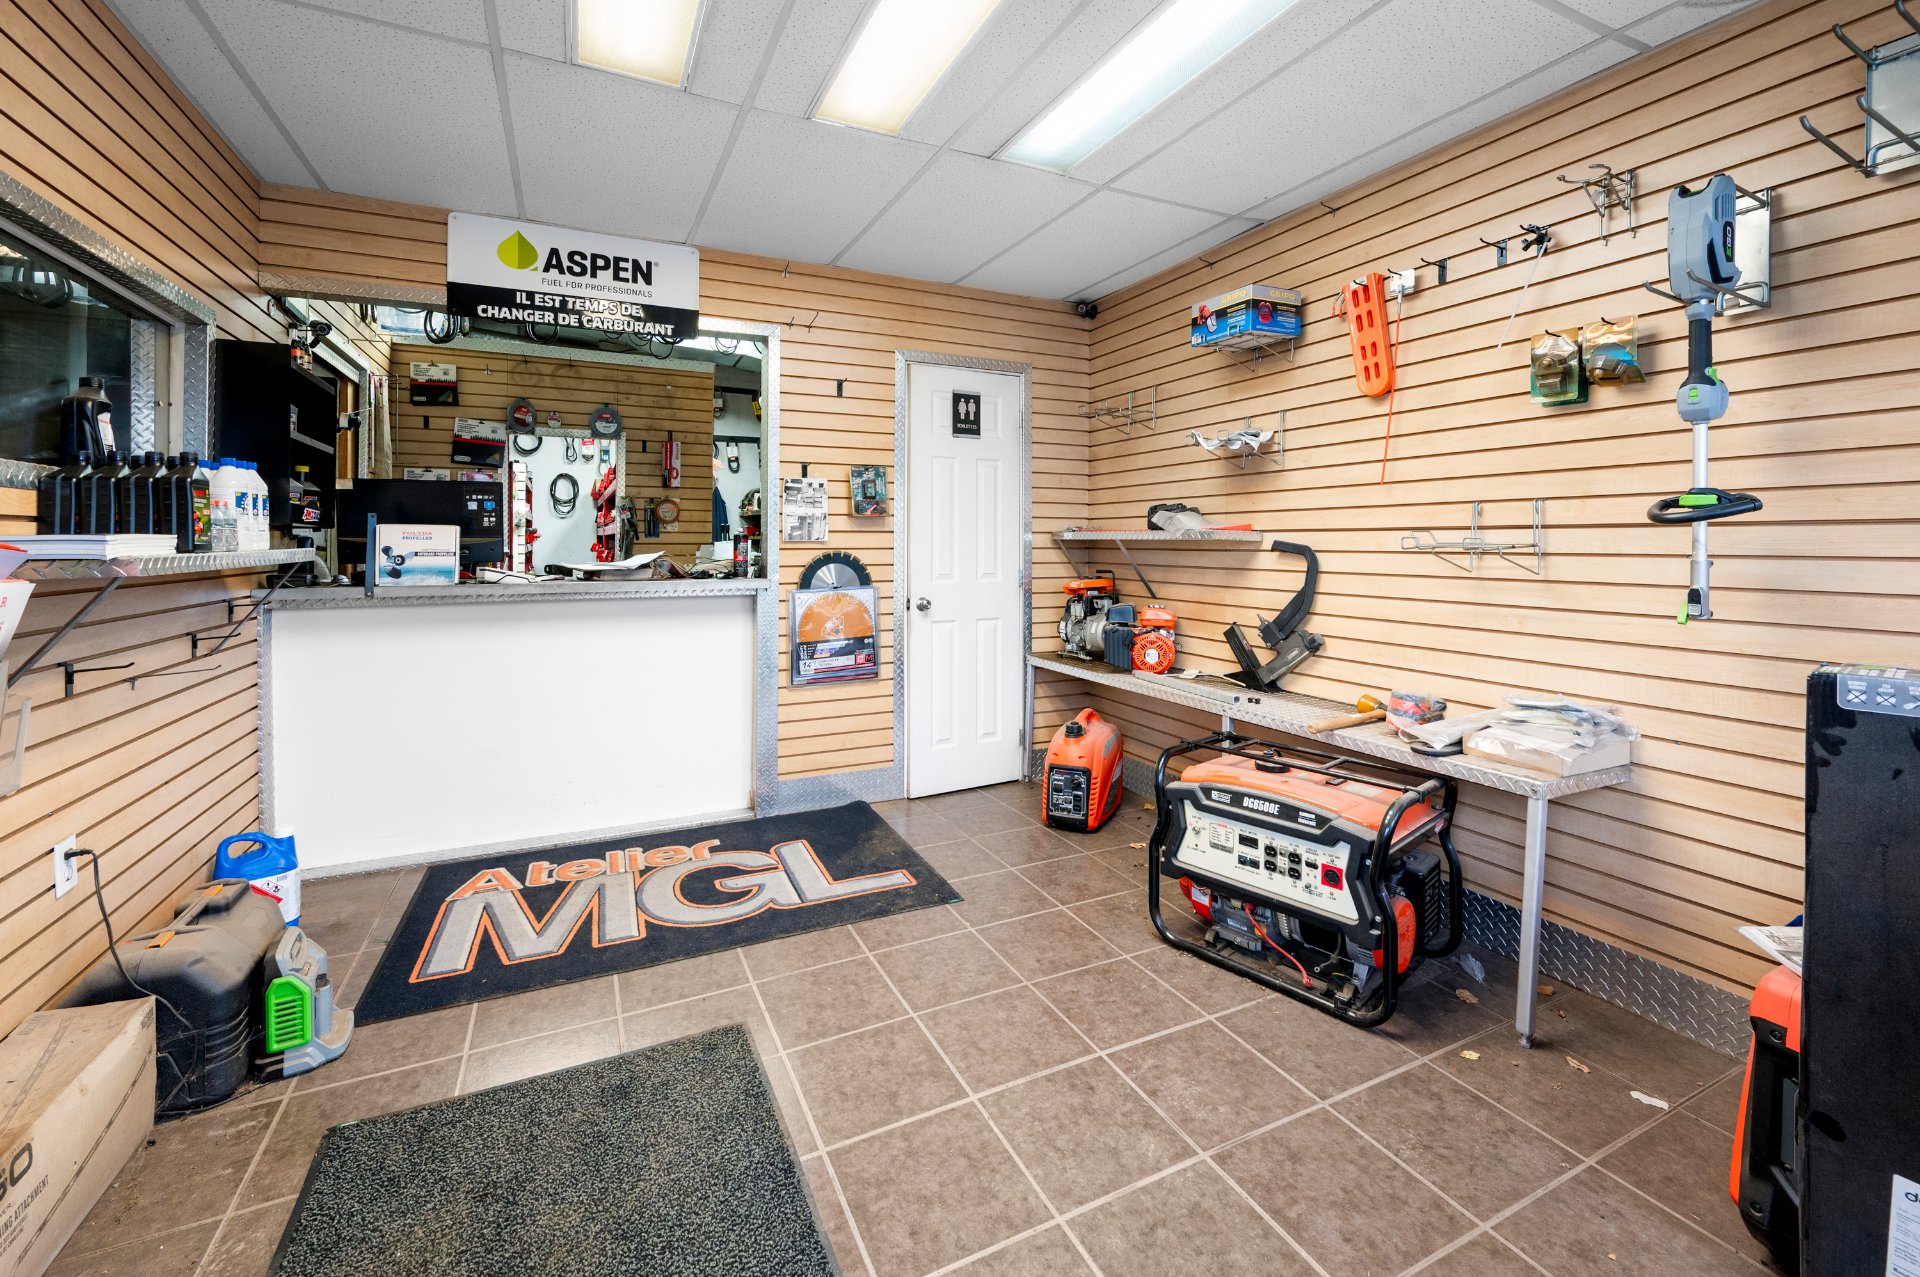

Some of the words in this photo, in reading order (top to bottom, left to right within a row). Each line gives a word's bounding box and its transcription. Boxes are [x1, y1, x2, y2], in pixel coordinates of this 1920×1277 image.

[542, 247, 653, 286] ASPEN
[516, 291, 530, 305] IL
[534, 293, 563, 310] EST
[565, 296, 618, 315] TEMPS
[620, 302, 642, 317] DE
[541, 277, 564, 288] FUEL
[566, 281, 583, 290] FOR
[585, 283, 653, 298] PROFESSIONALS
[1270, 291, 1295, 300] GRIPO
[477, 304, 555, 325] CHANGER
[558, 311, 580, 327] DE
[581, 314, 675, 336] CARBURANT
[445, 838, 721, 901] Atelier
[408, 839, 918, 983] MGL
[14, 1174, 49, 1221] ATTACHMENT
